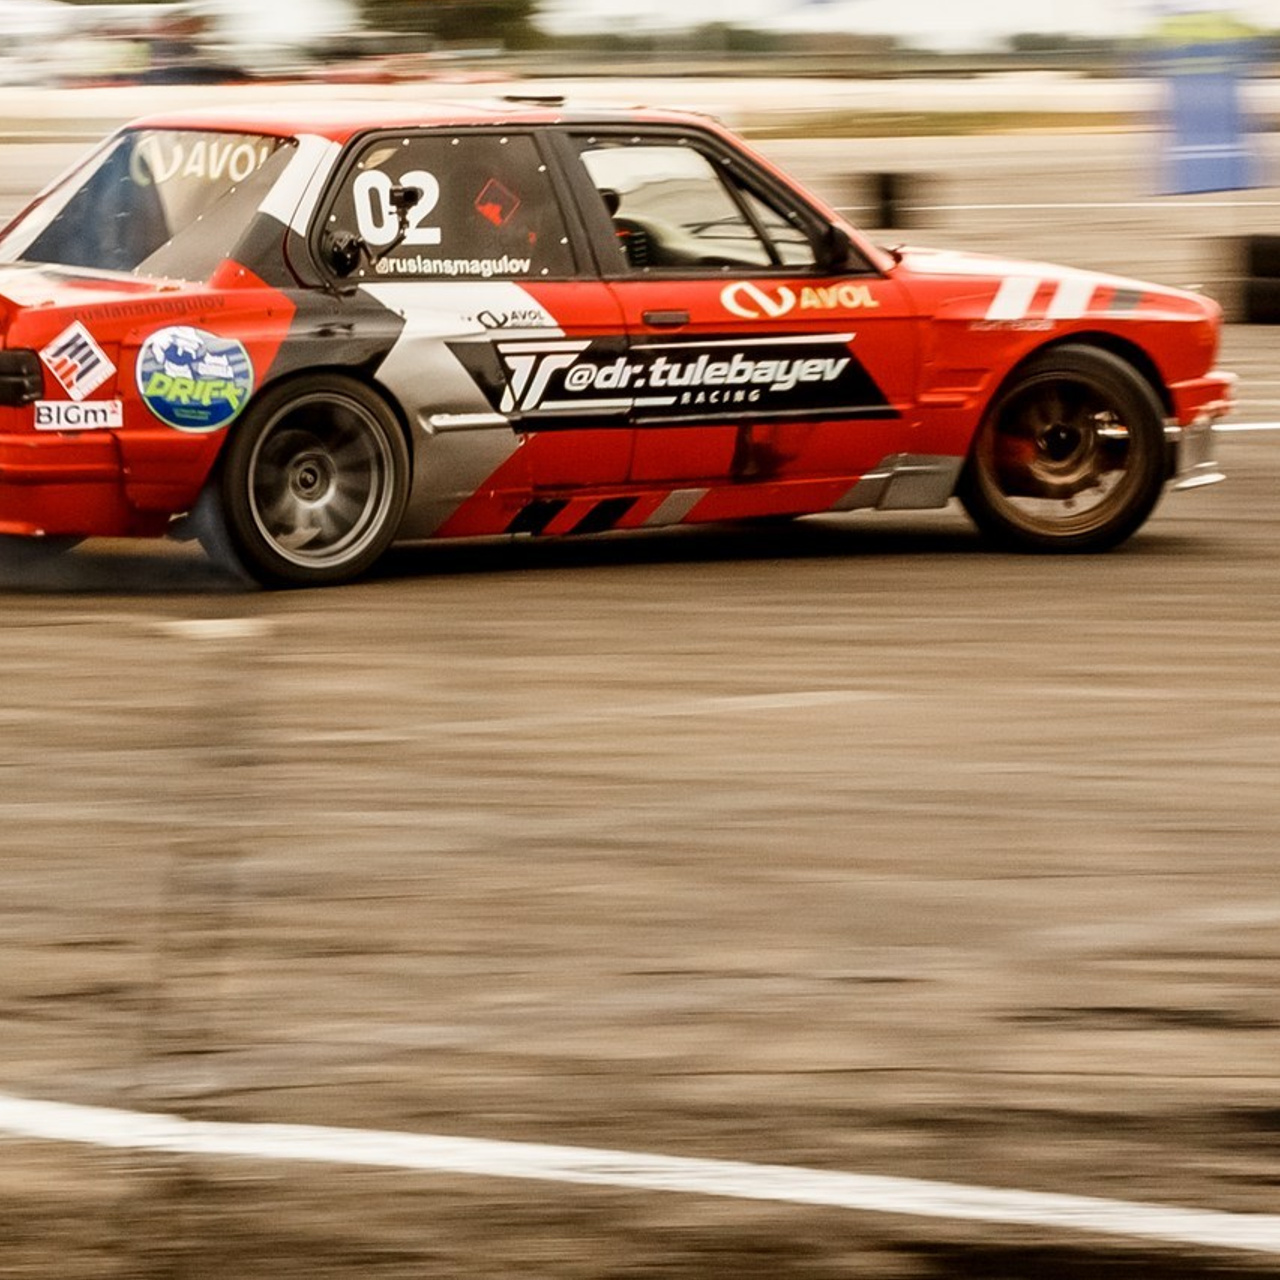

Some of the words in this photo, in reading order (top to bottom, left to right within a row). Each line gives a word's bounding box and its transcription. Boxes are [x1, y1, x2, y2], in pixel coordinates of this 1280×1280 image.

[353, 170, 441, 245] 02
[800, 285, 880, 309] AVOL
[510, 310, 545, 320] AVOL
[564, 353, 851, 392] @dr.tulebayev
[144, 371, 243, 411] DRIFT
[680, 390, 761, 405] RACING
